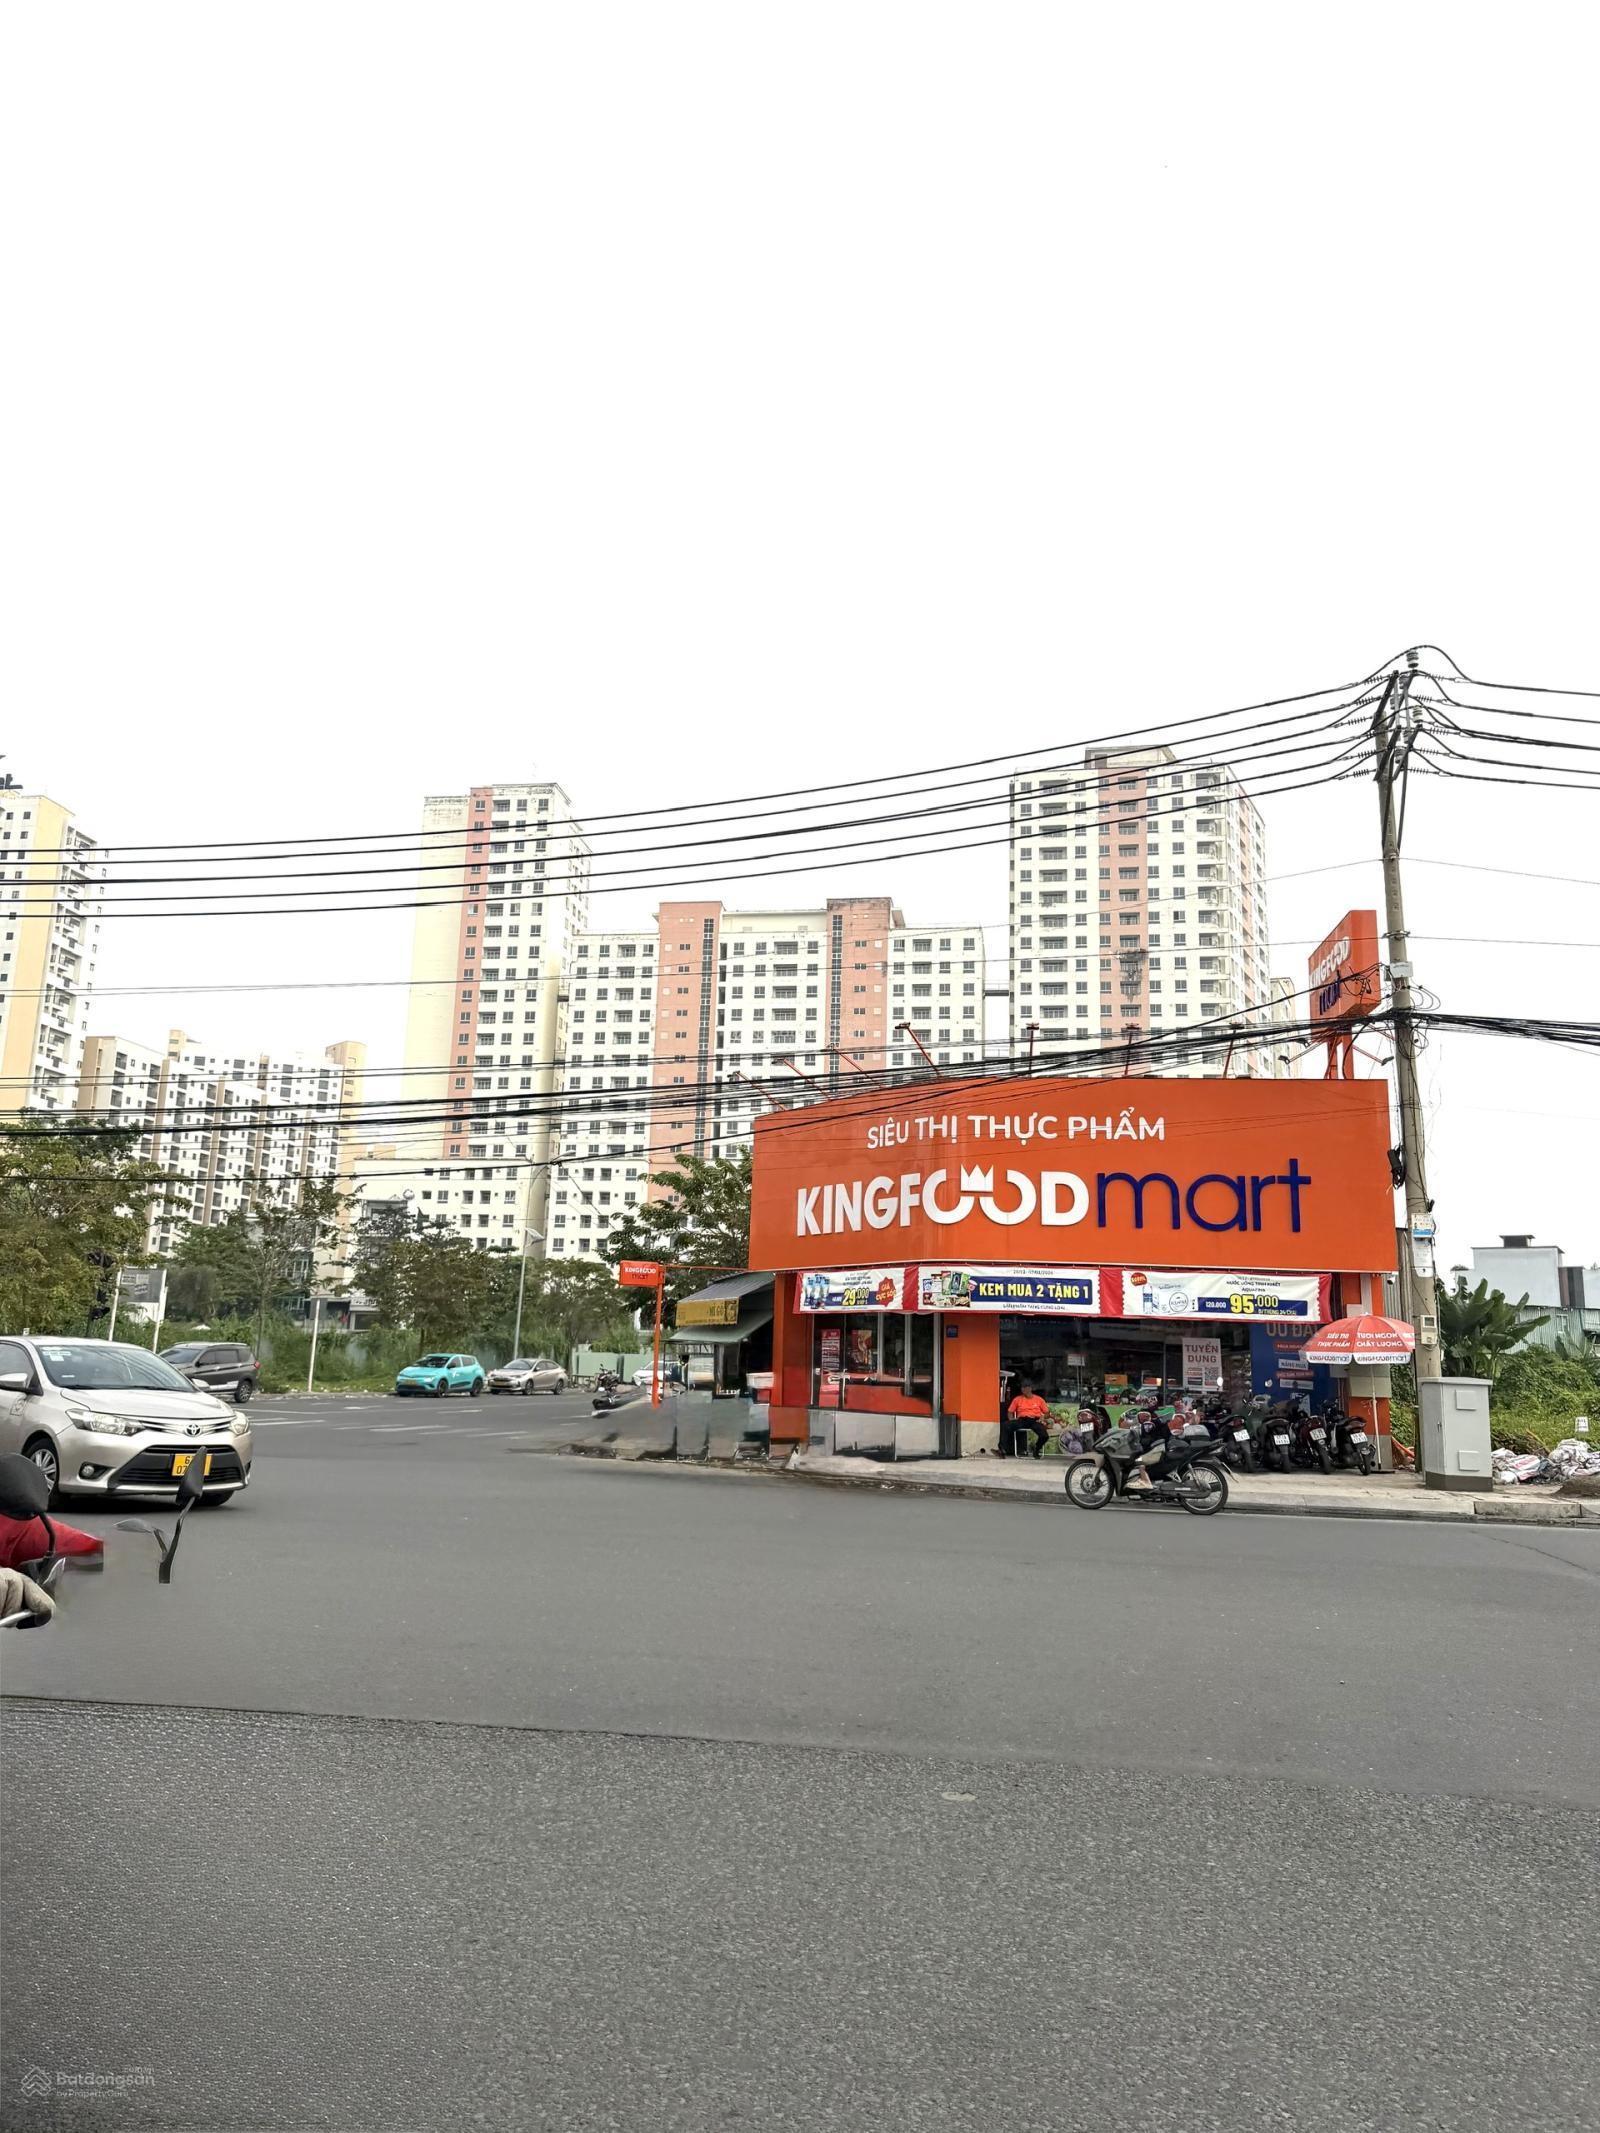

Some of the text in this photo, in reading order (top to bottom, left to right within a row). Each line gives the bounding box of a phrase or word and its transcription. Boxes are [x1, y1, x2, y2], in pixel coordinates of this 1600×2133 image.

[867, 1106, 1165, 1149] SIÊU THỊ THỰC PHẨM
[979, 1282, 1089, 1302] KEM MUA 2 TẶNG 1
[1184, 1341, 1219, 1353] TUYỂN
